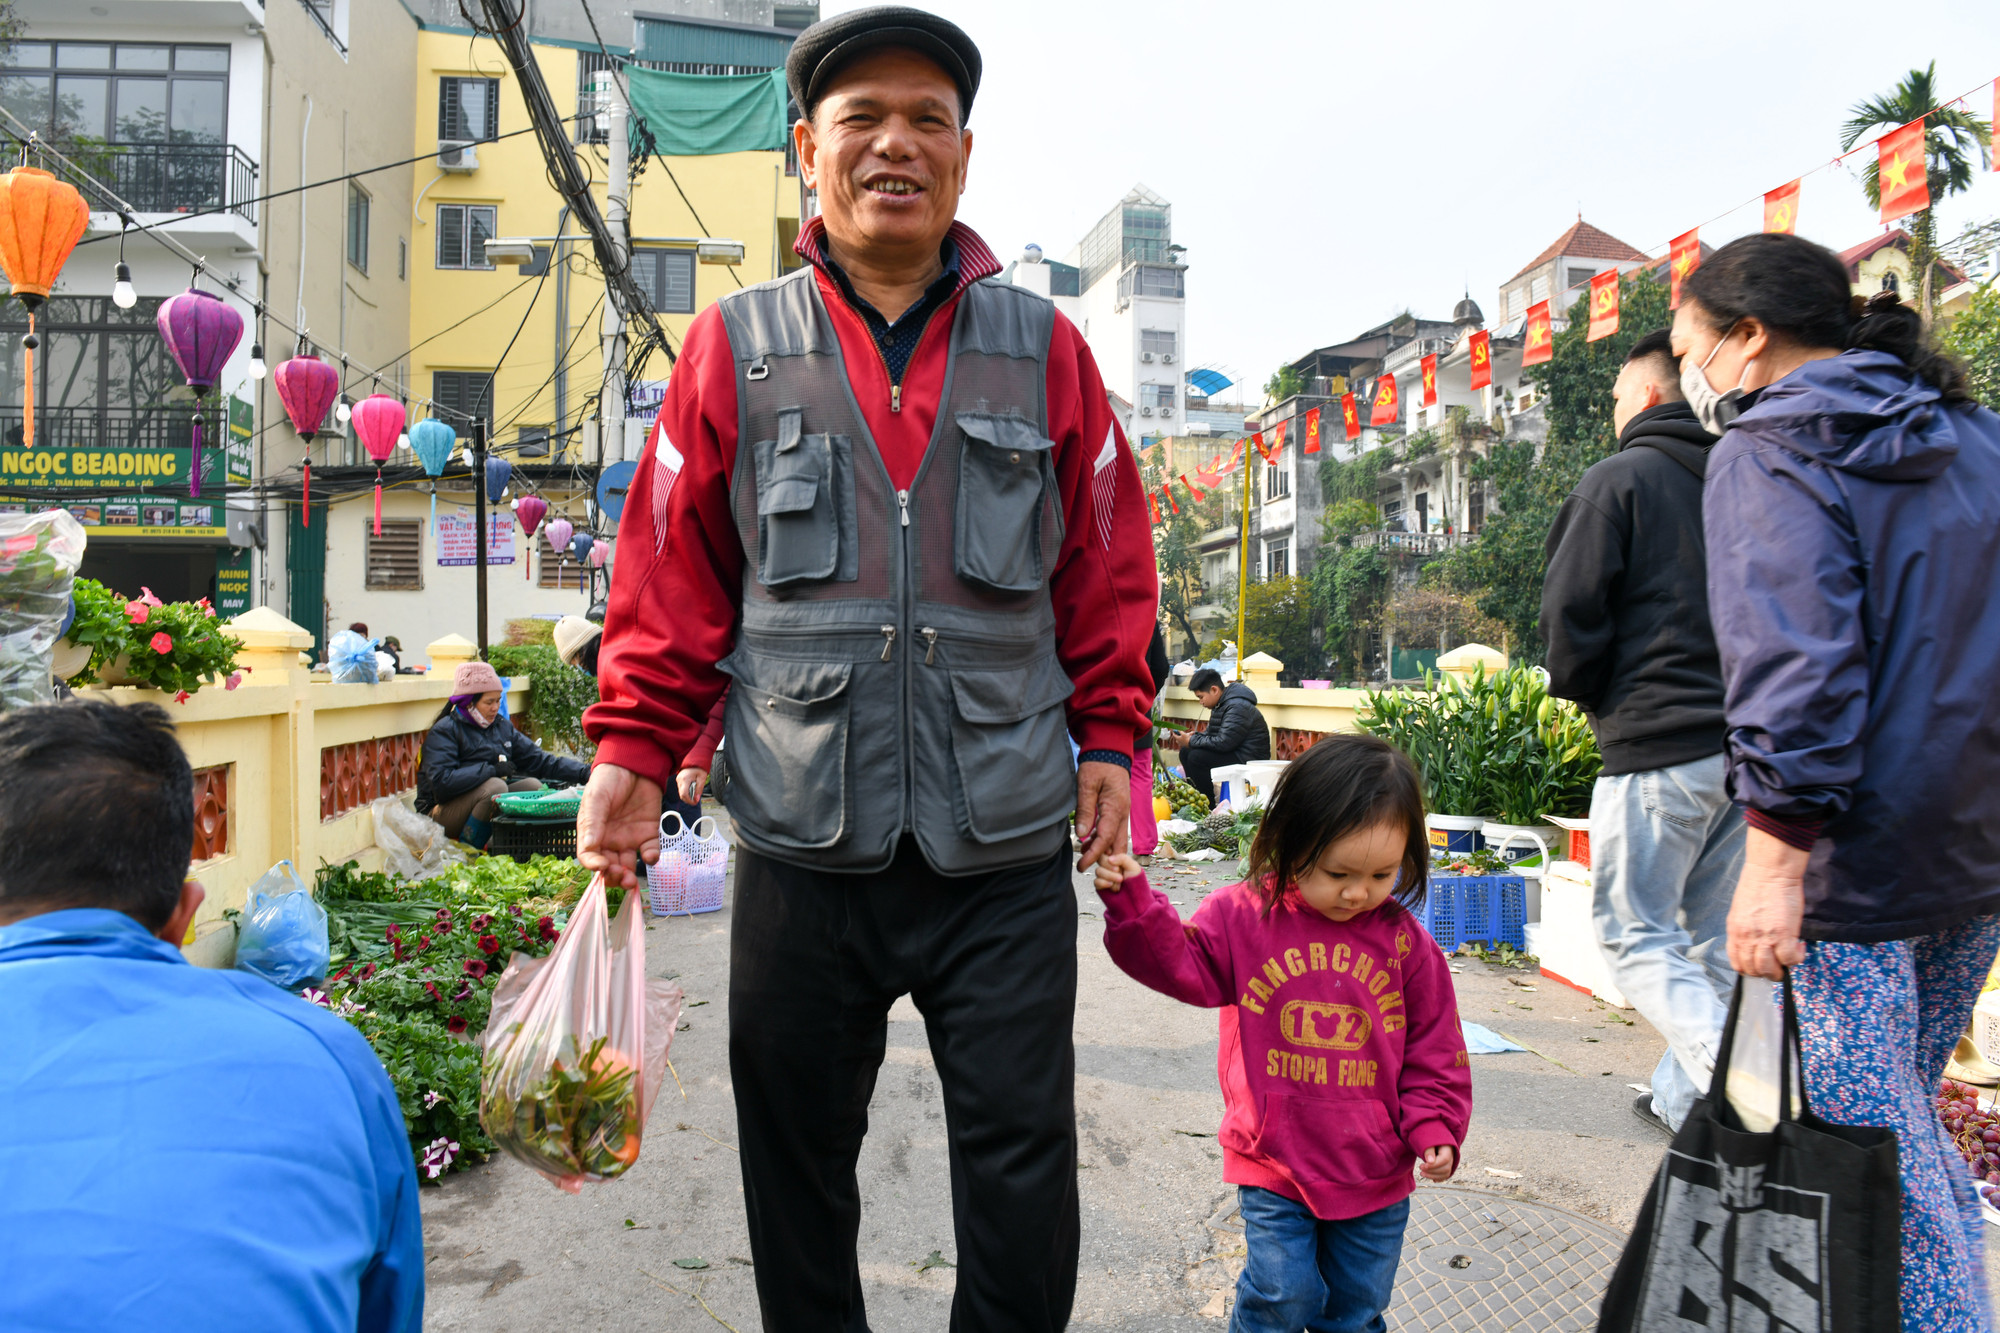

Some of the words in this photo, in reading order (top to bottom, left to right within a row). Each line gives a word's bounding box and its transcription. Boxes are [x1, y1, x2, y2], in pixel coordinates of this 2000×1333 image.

[2, 451, 67, 479] NGỌC
[72, 452, 176, 476] BEADING
[218, 569, 249, 579] MINH
[219, 582, 248, 594] NGỌC
[222, 598, 244, 608] MAY
[1240, 942, 1406, 1034] FANGRCHONG
[1266, 1048, 1328, 1085] STOPA
[1337, 1058, 1378, 1087] FANG
